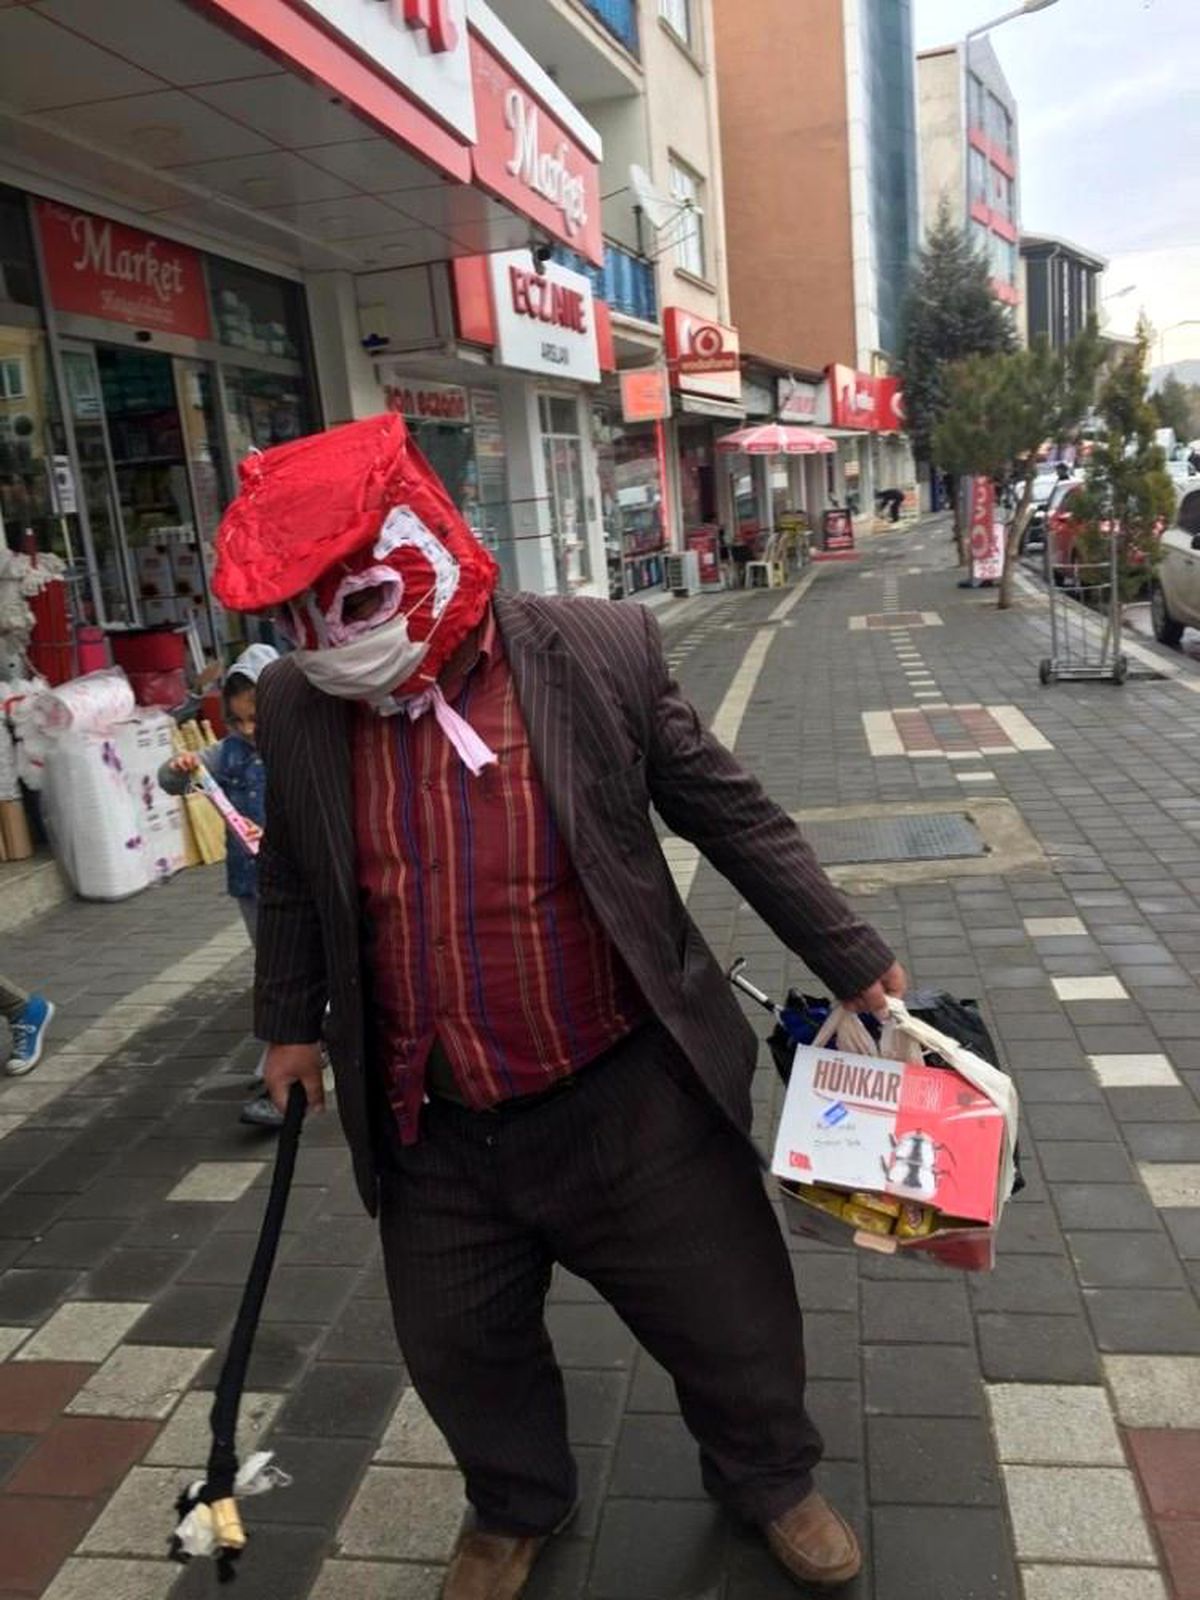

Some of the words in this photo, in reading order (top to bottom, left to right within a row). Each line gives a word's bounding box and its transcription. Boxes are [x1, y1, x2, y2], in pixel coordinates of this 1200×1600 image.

[504, 88, 588, 237] Market
[71, 215, 185, 302] Market
[509, 264, 587, 334] ECZANE
[812, 1058, 901, 1103] HÜNKAR
